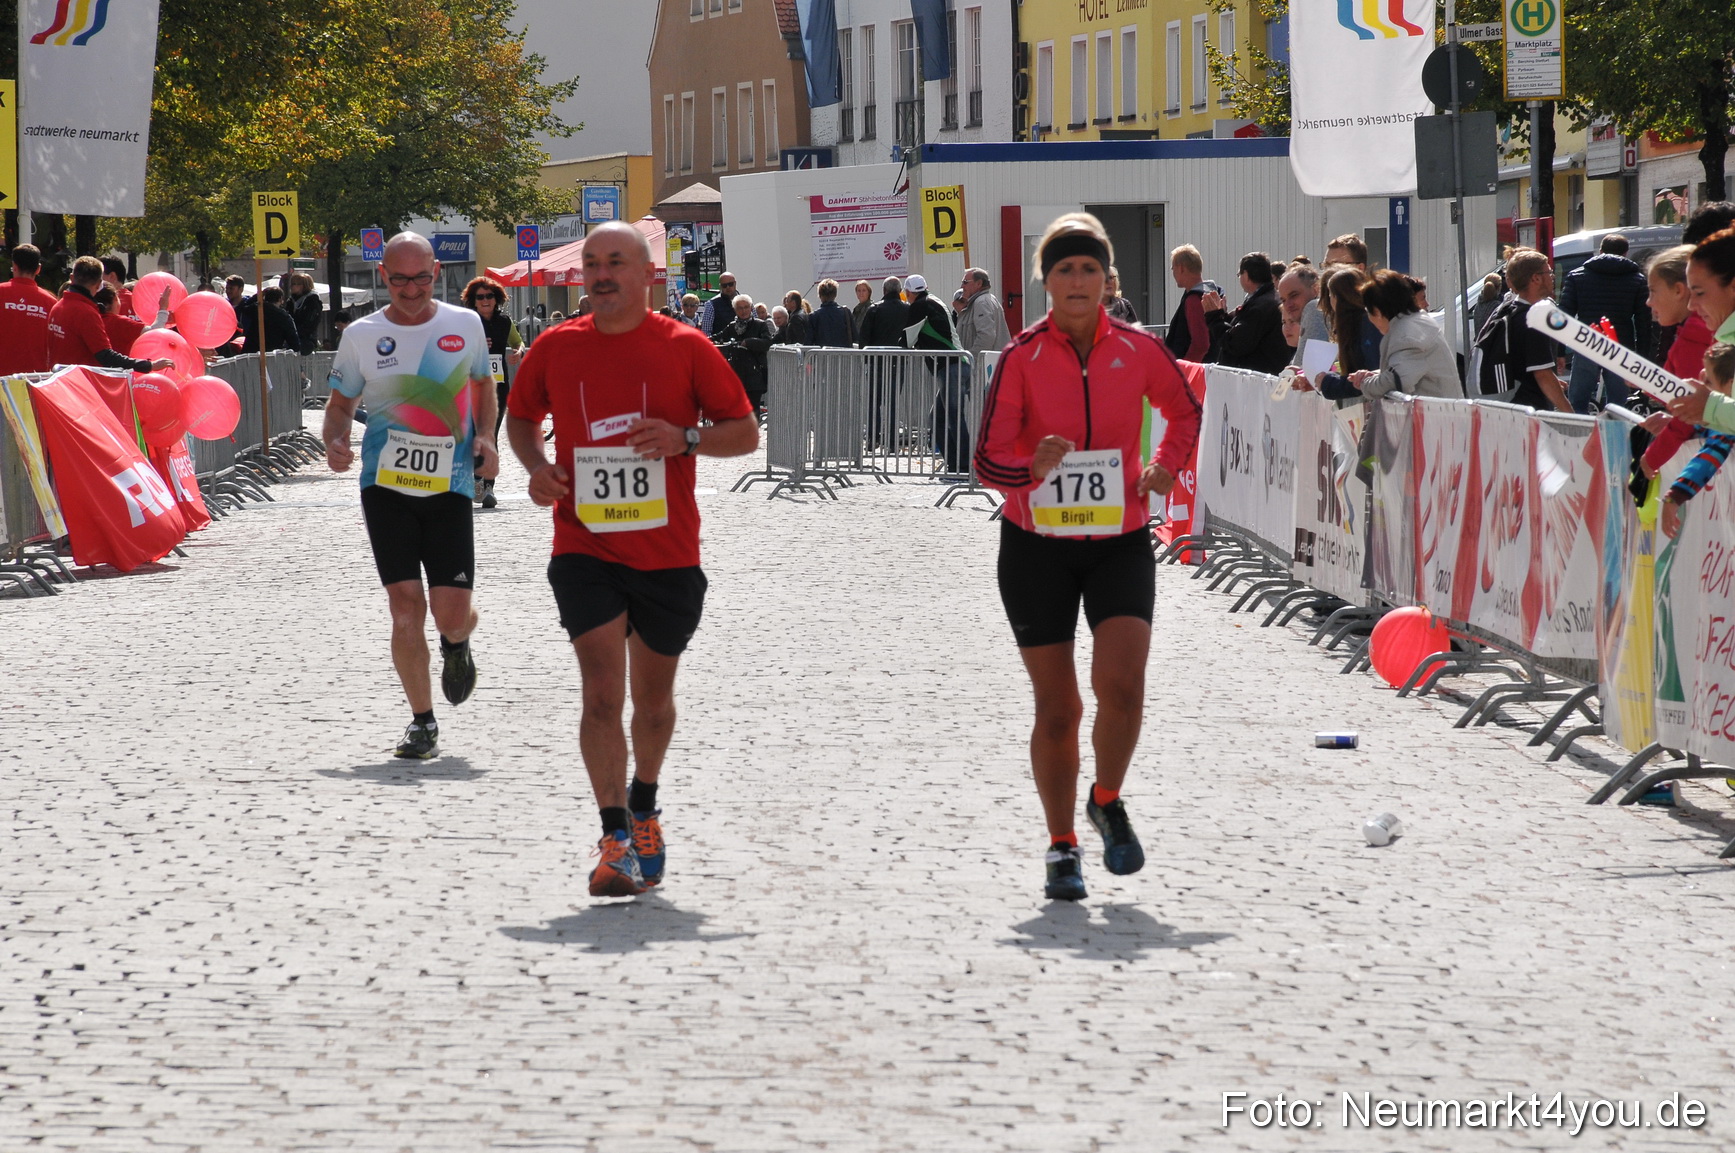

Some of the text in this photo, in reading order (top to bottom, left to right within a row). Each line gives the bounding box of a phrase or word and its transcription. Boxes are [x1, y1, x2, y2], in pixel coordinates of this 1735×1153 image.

[1460, 26, 1503, 38] Ulmer Gass
[79, 129, 139, 143] neumarkt
[257, 194, 293, 207] Block
[828, 197, 857, 205] DAHMIT
[925, 188, 960, 202] Block
[264, 212, 288, 244] D
[830, 223, 877, 235] DAHMIT
[932, 206, 957, 239] D
[439, 241, 467, 250] APOLLO
[520, 250, 538, 258] TAXI
[1574, 325, 1620, 361] BMW
[377, 357, 398, 366] PARTL
[605, 419, 628, 432] DEHN
[389, 434, 443, 449] PARTL Neumarkt
[394, 447, 439, 474] 200
[577, 456, 604, 464] PARTL
[1061, 460, 1105, 470] Neumarkt
[396, 475, 431, 489] Norbert
[593, 467, 650, 500] 318
[1050, 472, 1106, 504] 178
[605, 506, 640, 520] Mario
[1061, 511, 1094, 526] Birgit
